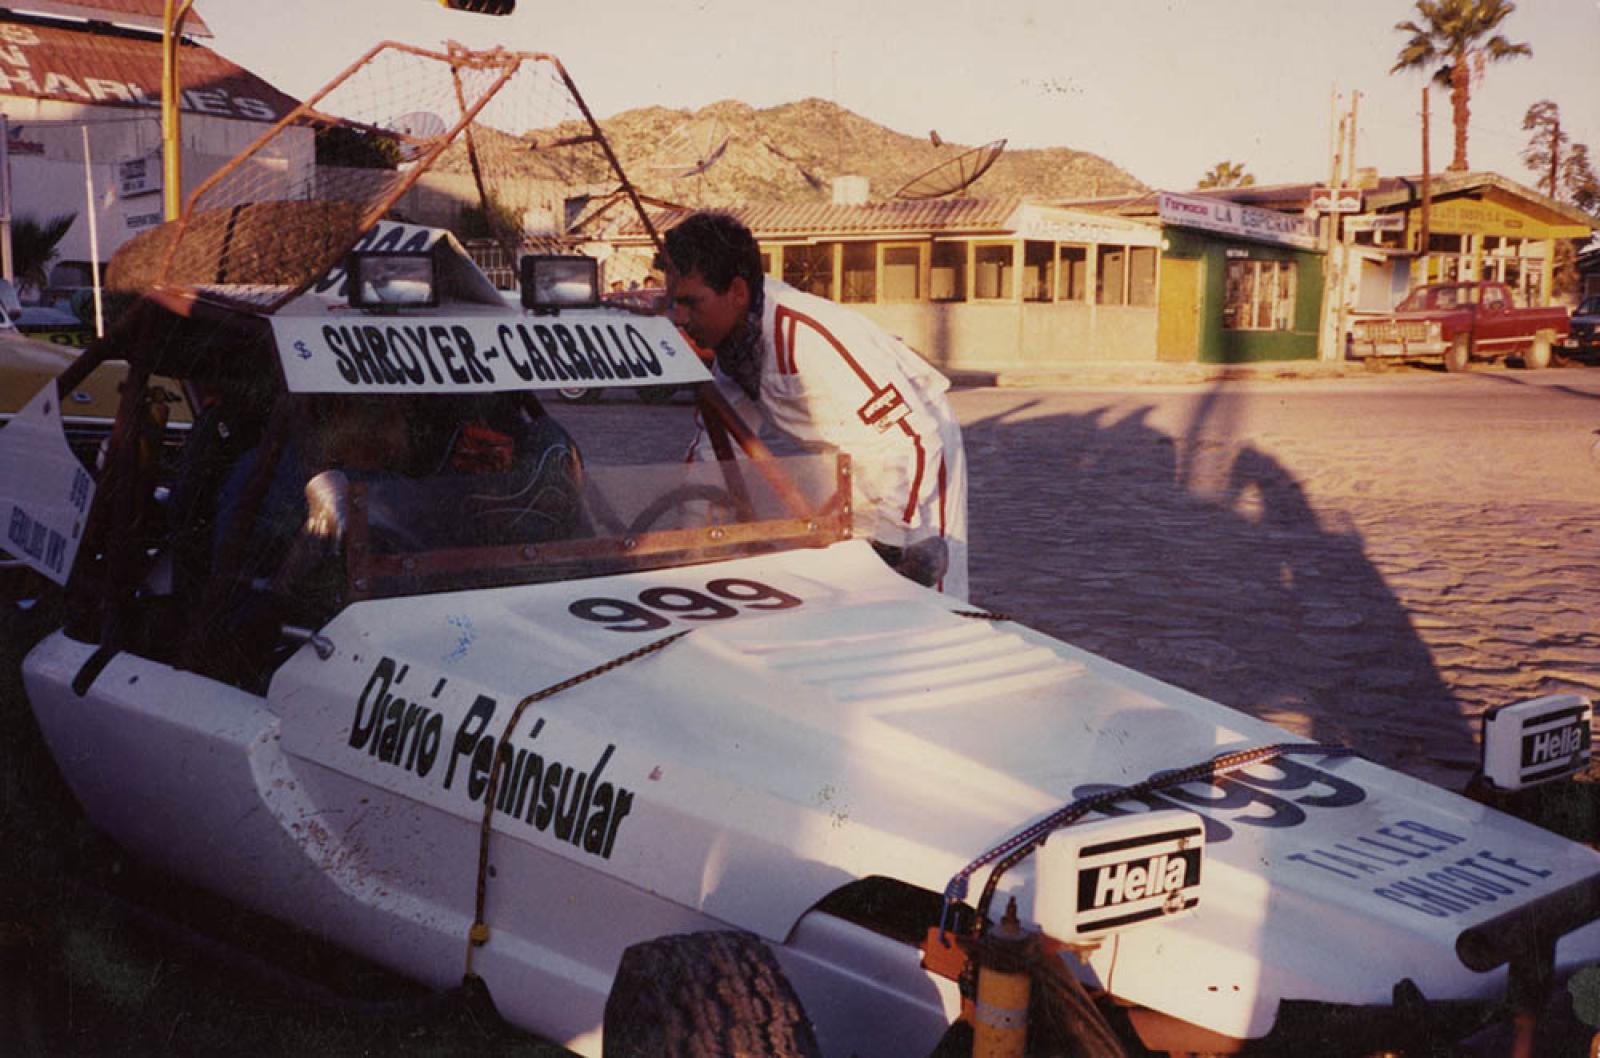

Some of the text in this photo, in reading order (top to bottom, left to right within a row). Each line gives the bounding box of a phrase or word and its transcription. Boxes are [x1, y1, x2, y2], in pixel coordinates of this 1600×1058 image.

[1215, 206, 1233, 224] LA
[568, 578, 803, 633] 999
[1532, 725, 1582, 764] Hella
[443, 694, 635, 860] Peninsular
[1285, 820, 1467, 880] TALLER
[1094, 855, 1188, 907] Hella
